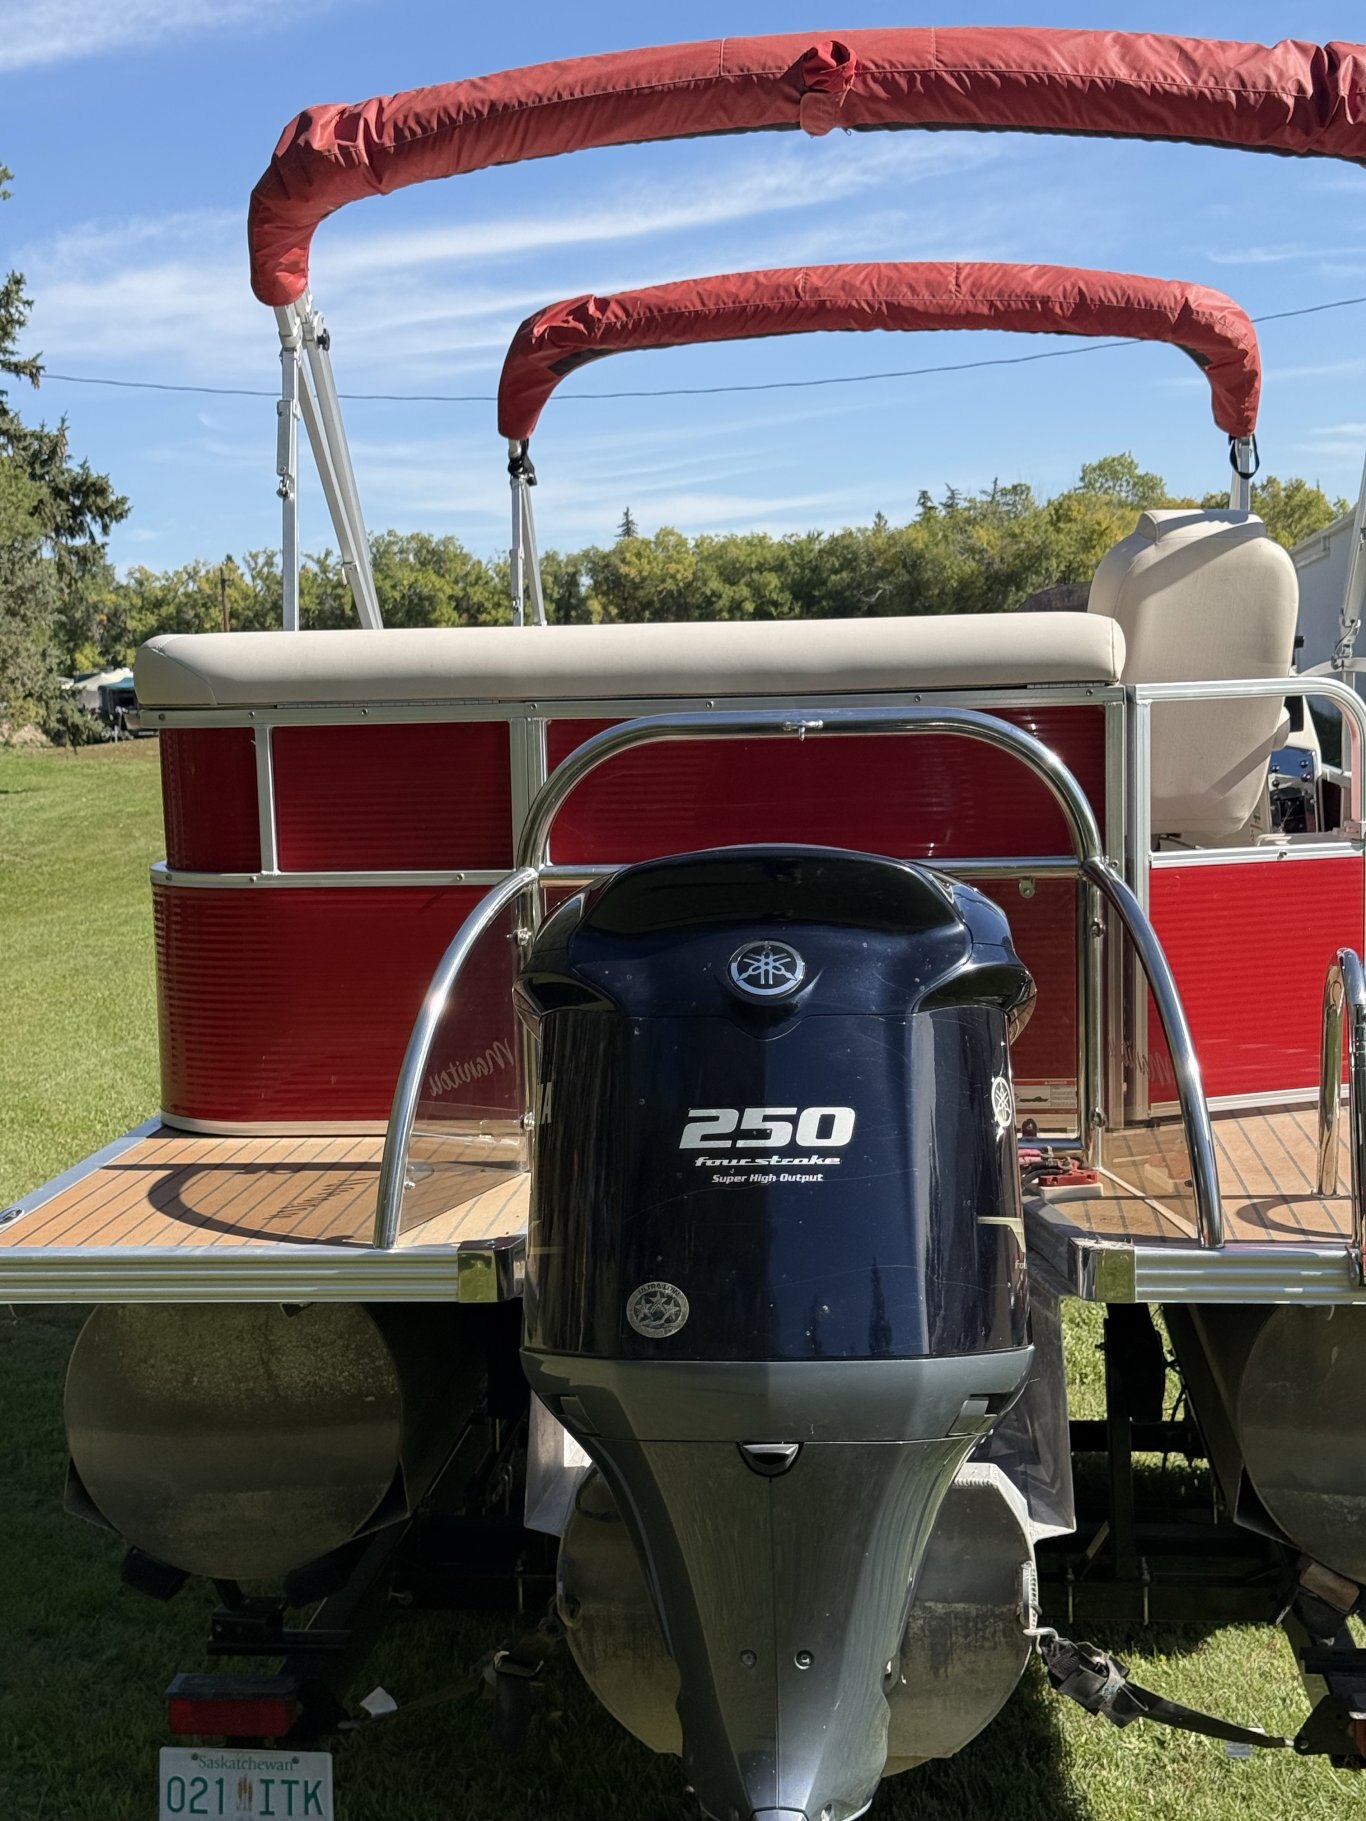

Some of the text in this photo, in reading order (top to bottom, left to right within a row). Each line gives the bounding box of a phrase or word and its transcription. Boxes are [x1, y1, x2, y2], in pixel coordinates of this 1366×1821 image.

[679, 1107, 856, 1149] 250
[695, 1155, 841, 1167] fourstroke
[712, 1173, 824, 1184] Super High Output
[198, 1754, 293, 1772] Saskatchewan
[167, 1776, 323, 1816] 021 ITK
